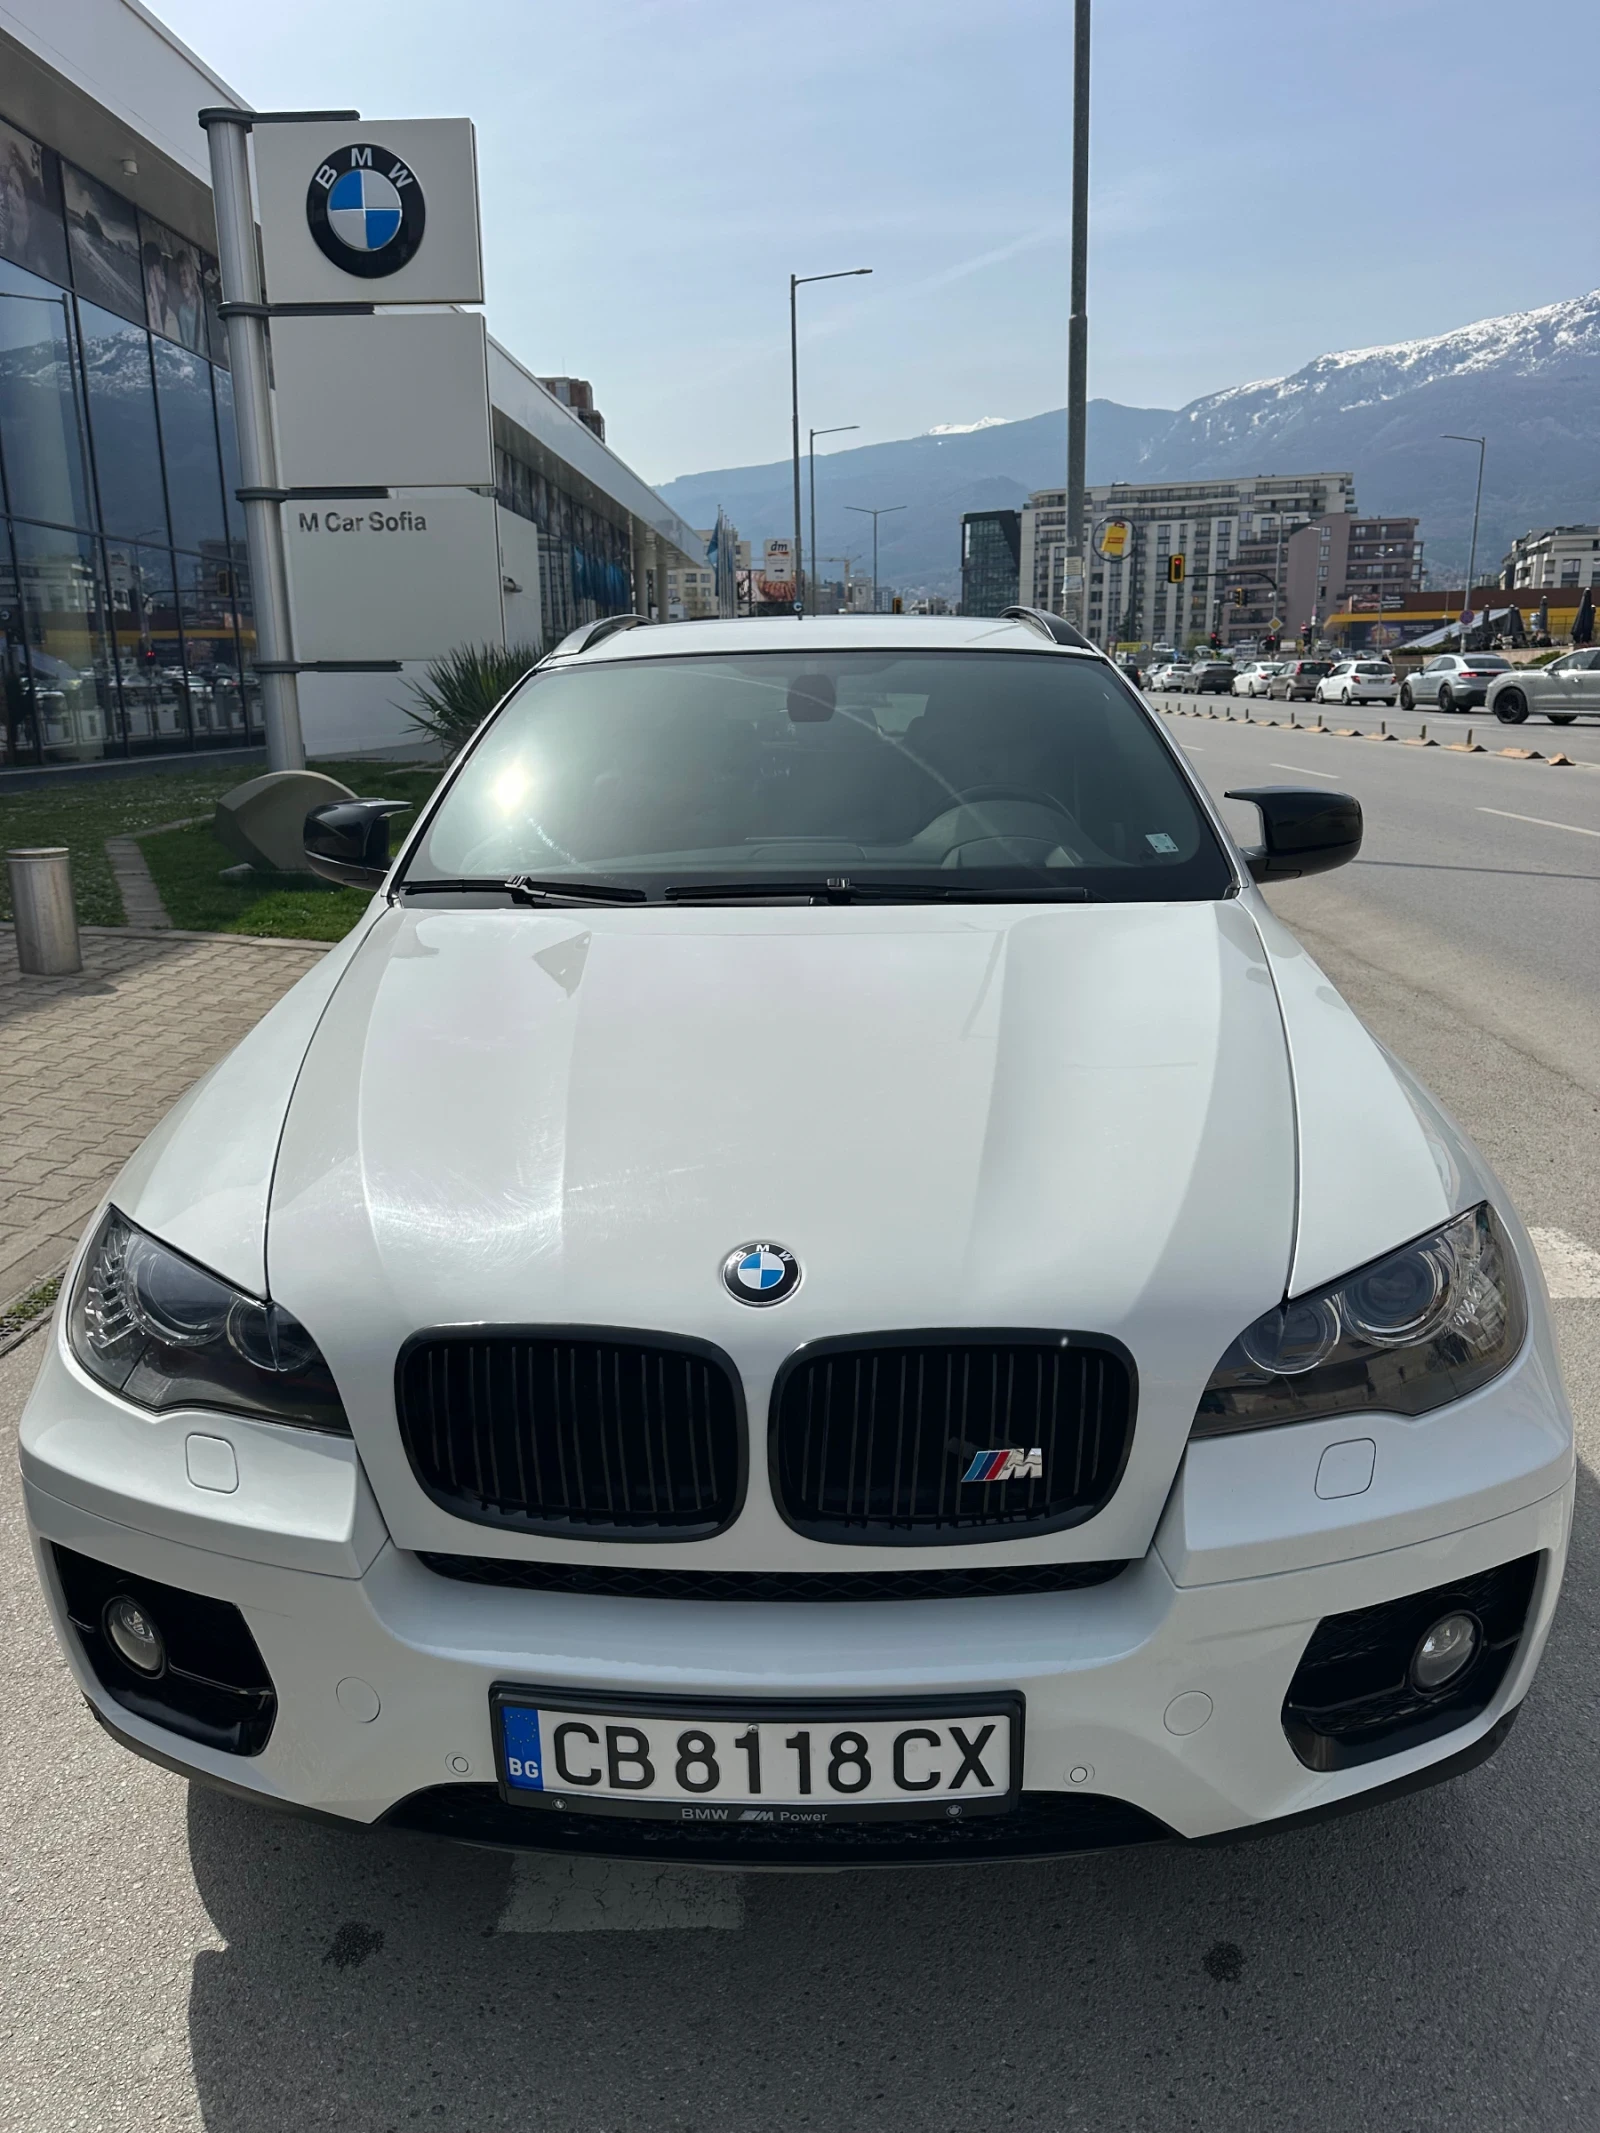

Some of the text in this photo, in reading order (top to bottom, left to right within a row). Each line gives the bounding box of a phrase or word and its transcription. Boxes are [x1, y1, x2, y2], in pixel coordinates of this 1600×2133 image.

[315, 148, 414, 190] BMW
[299, 511, 427, 532] M Car Sofia
[771, 541, 788, 551] dm
[730, 1244, 794, 1262] BMW
[508, 1757, 539, 1778] BG
[681, 1808, 729, 1820] BMW
[780, 1811, 828, 1821] Power
